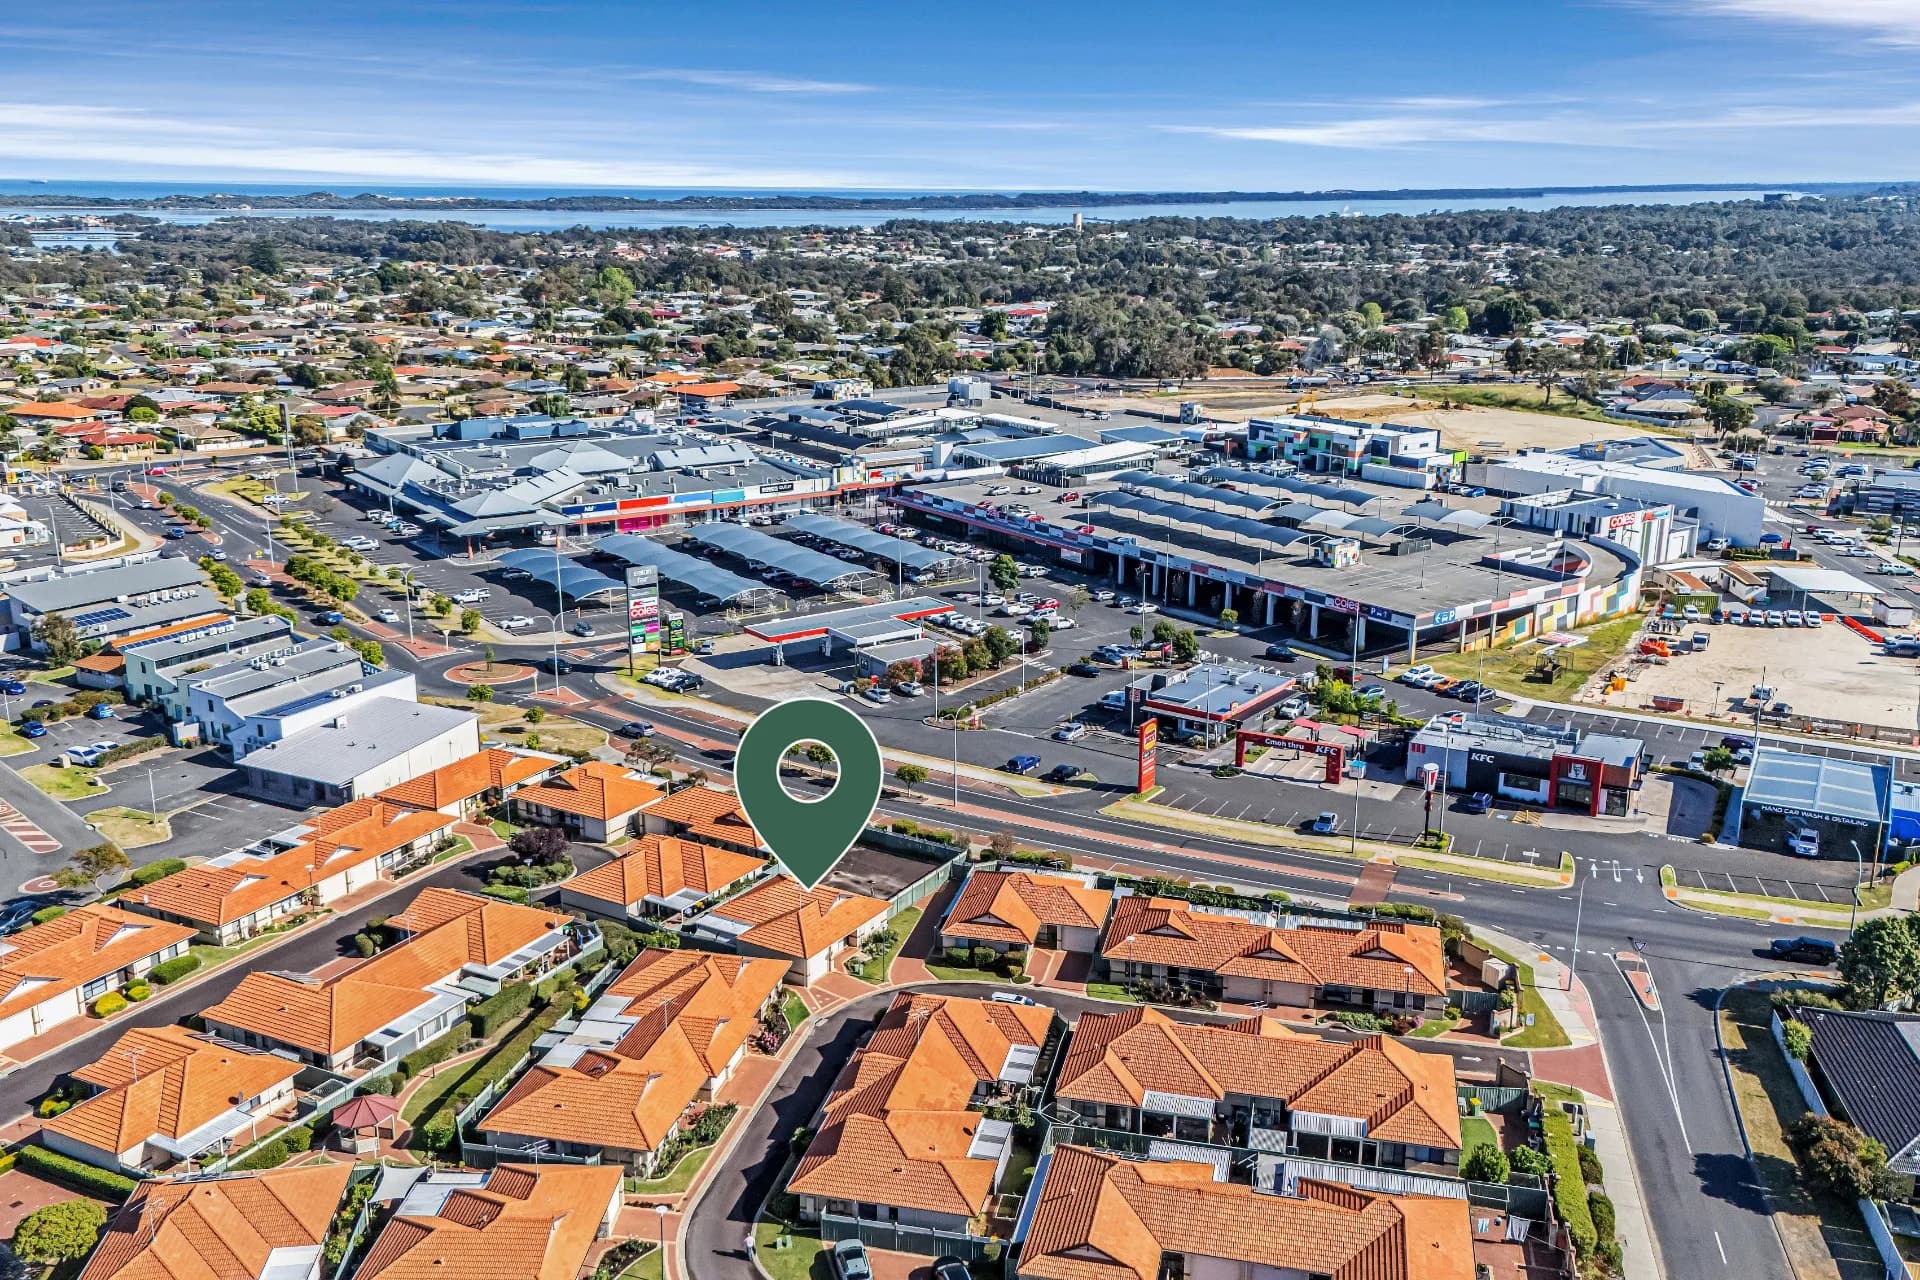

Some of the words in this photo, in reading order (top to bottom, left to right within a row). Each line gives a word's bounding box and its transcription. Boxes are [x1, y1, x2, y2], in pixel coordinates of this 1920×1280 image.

[1610, 513, 1636, 527] coles
[1334, 597, 1360, 611] coles
[630, 606, 658, 618] coles
[1449, 610, 1455, 619] P
[1264, 738, 1287, 748] Cmon
[1288, 741, 1305, 750] thru
[1315, 745, 1338, 756] KFC
[1471, 752, 1495, 764] KFC
[1761, 805, 1783, 813] HAND
[1784, 808, 1800, 816] CAR
[1801, 810, 1823, 820] WASH
[1831, 816, 1869, 827] DETAILING
